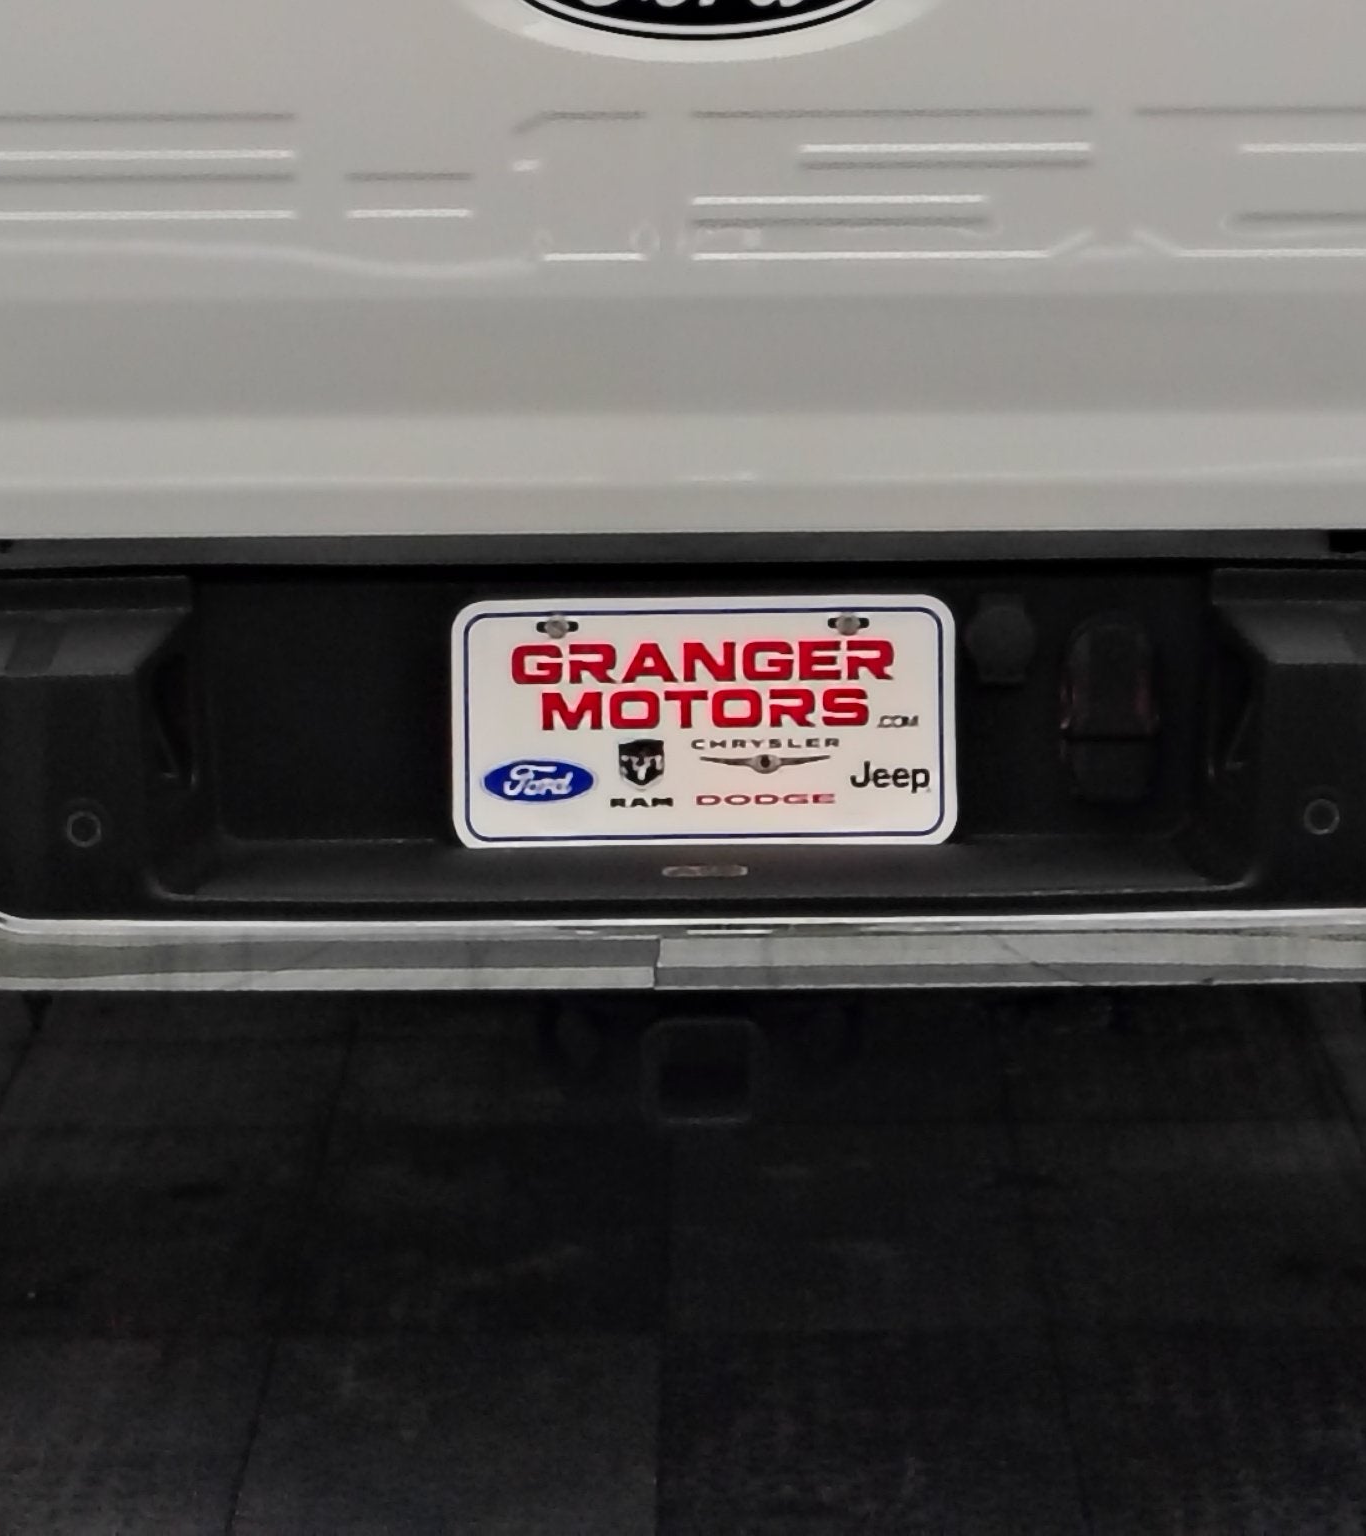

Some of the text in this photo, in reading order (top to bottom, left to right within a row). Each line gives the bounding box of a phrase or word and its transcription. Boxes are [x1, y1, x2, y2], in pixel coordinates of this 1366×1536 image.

[511, 639, 894, 684] GRANGER
[541, 688, 869, 730] MOTORS
[691, 737, 840, 750] CHRYSLER
[503, 764, 573, 796] Ford
[850, 761, 930, 793] Jeep
[610, 797, 673, 808] RAM
[696, 794, 836, 806] DODGE
